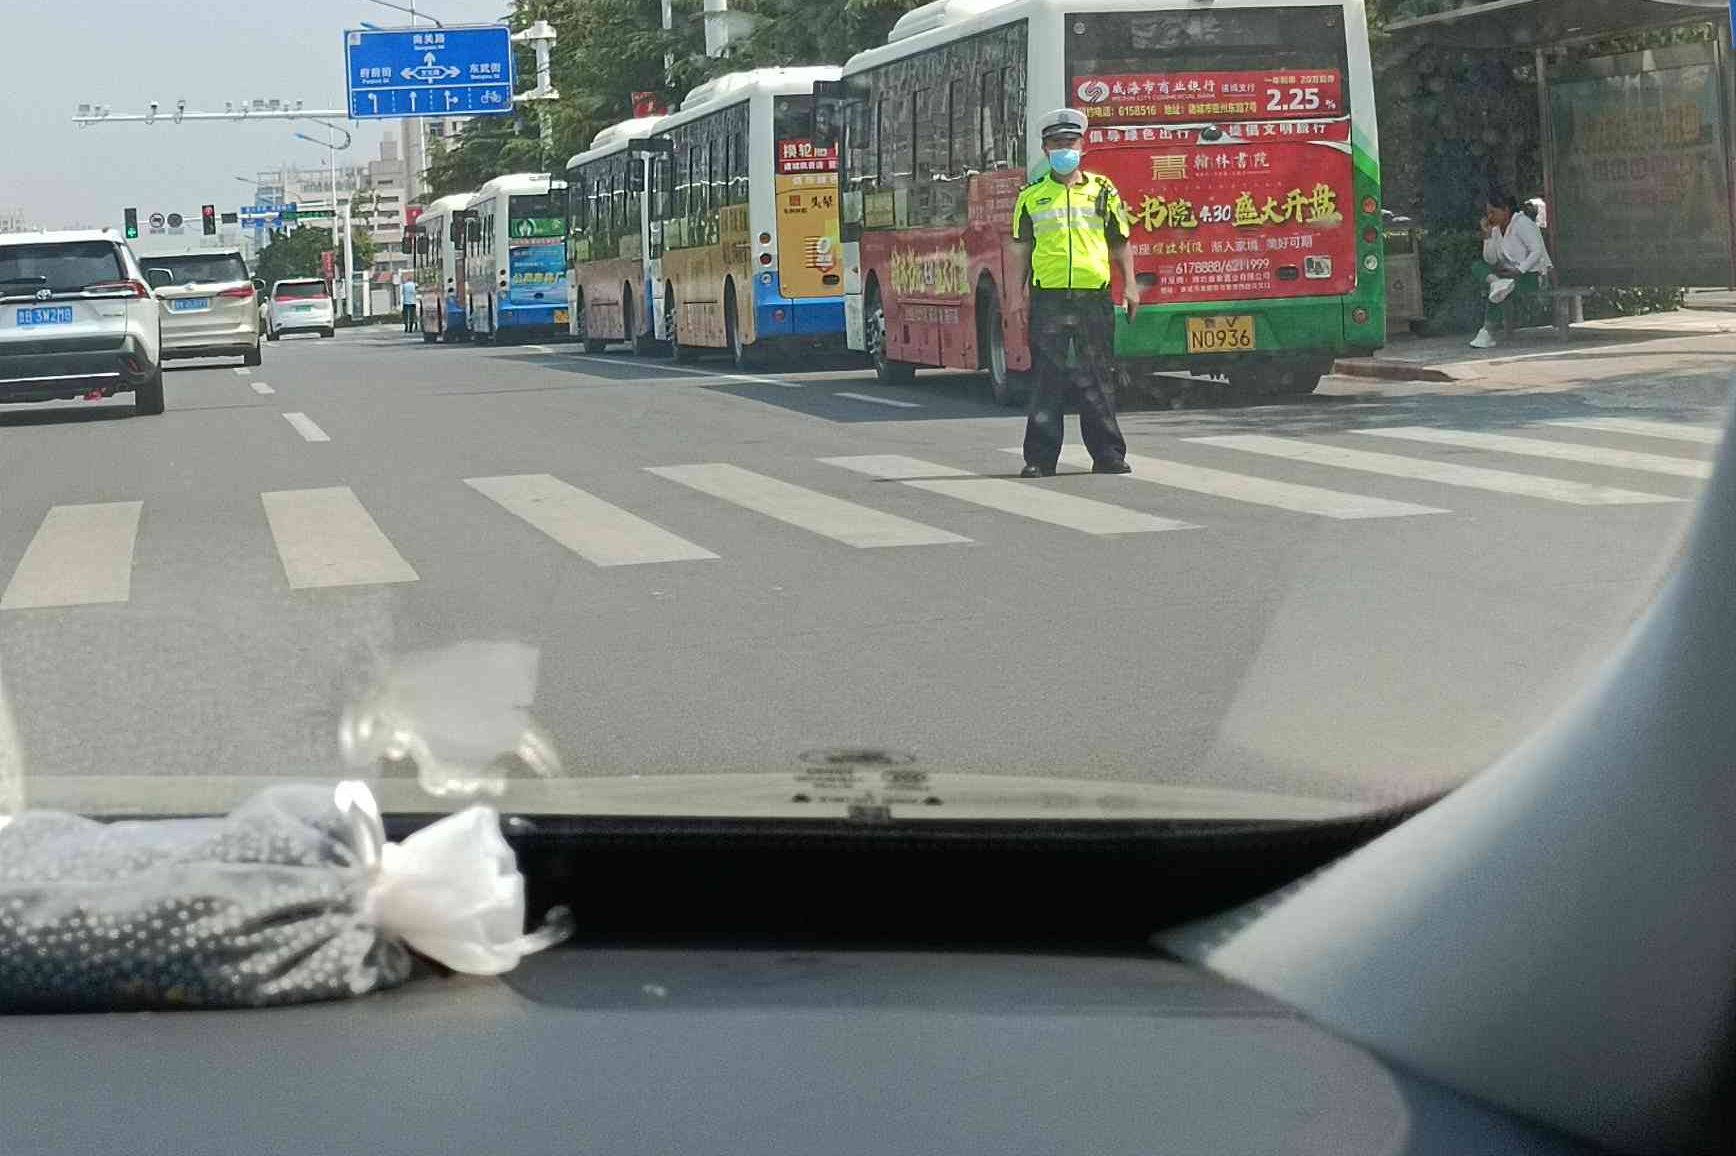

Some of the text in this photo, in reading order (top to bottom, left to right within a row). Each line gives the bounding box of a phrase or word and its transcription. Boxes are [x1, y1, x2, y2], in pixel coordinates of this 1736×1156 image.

[1112, 79, 1216, 96] 威海市商业银行
[1266, 88, 1320, 111] 2.25
[1199, 204, 1231, 222] 4.30
[1231, 182, 1343, 228] 盛大开盘
[1192, 329, 1250, 349] N0936
